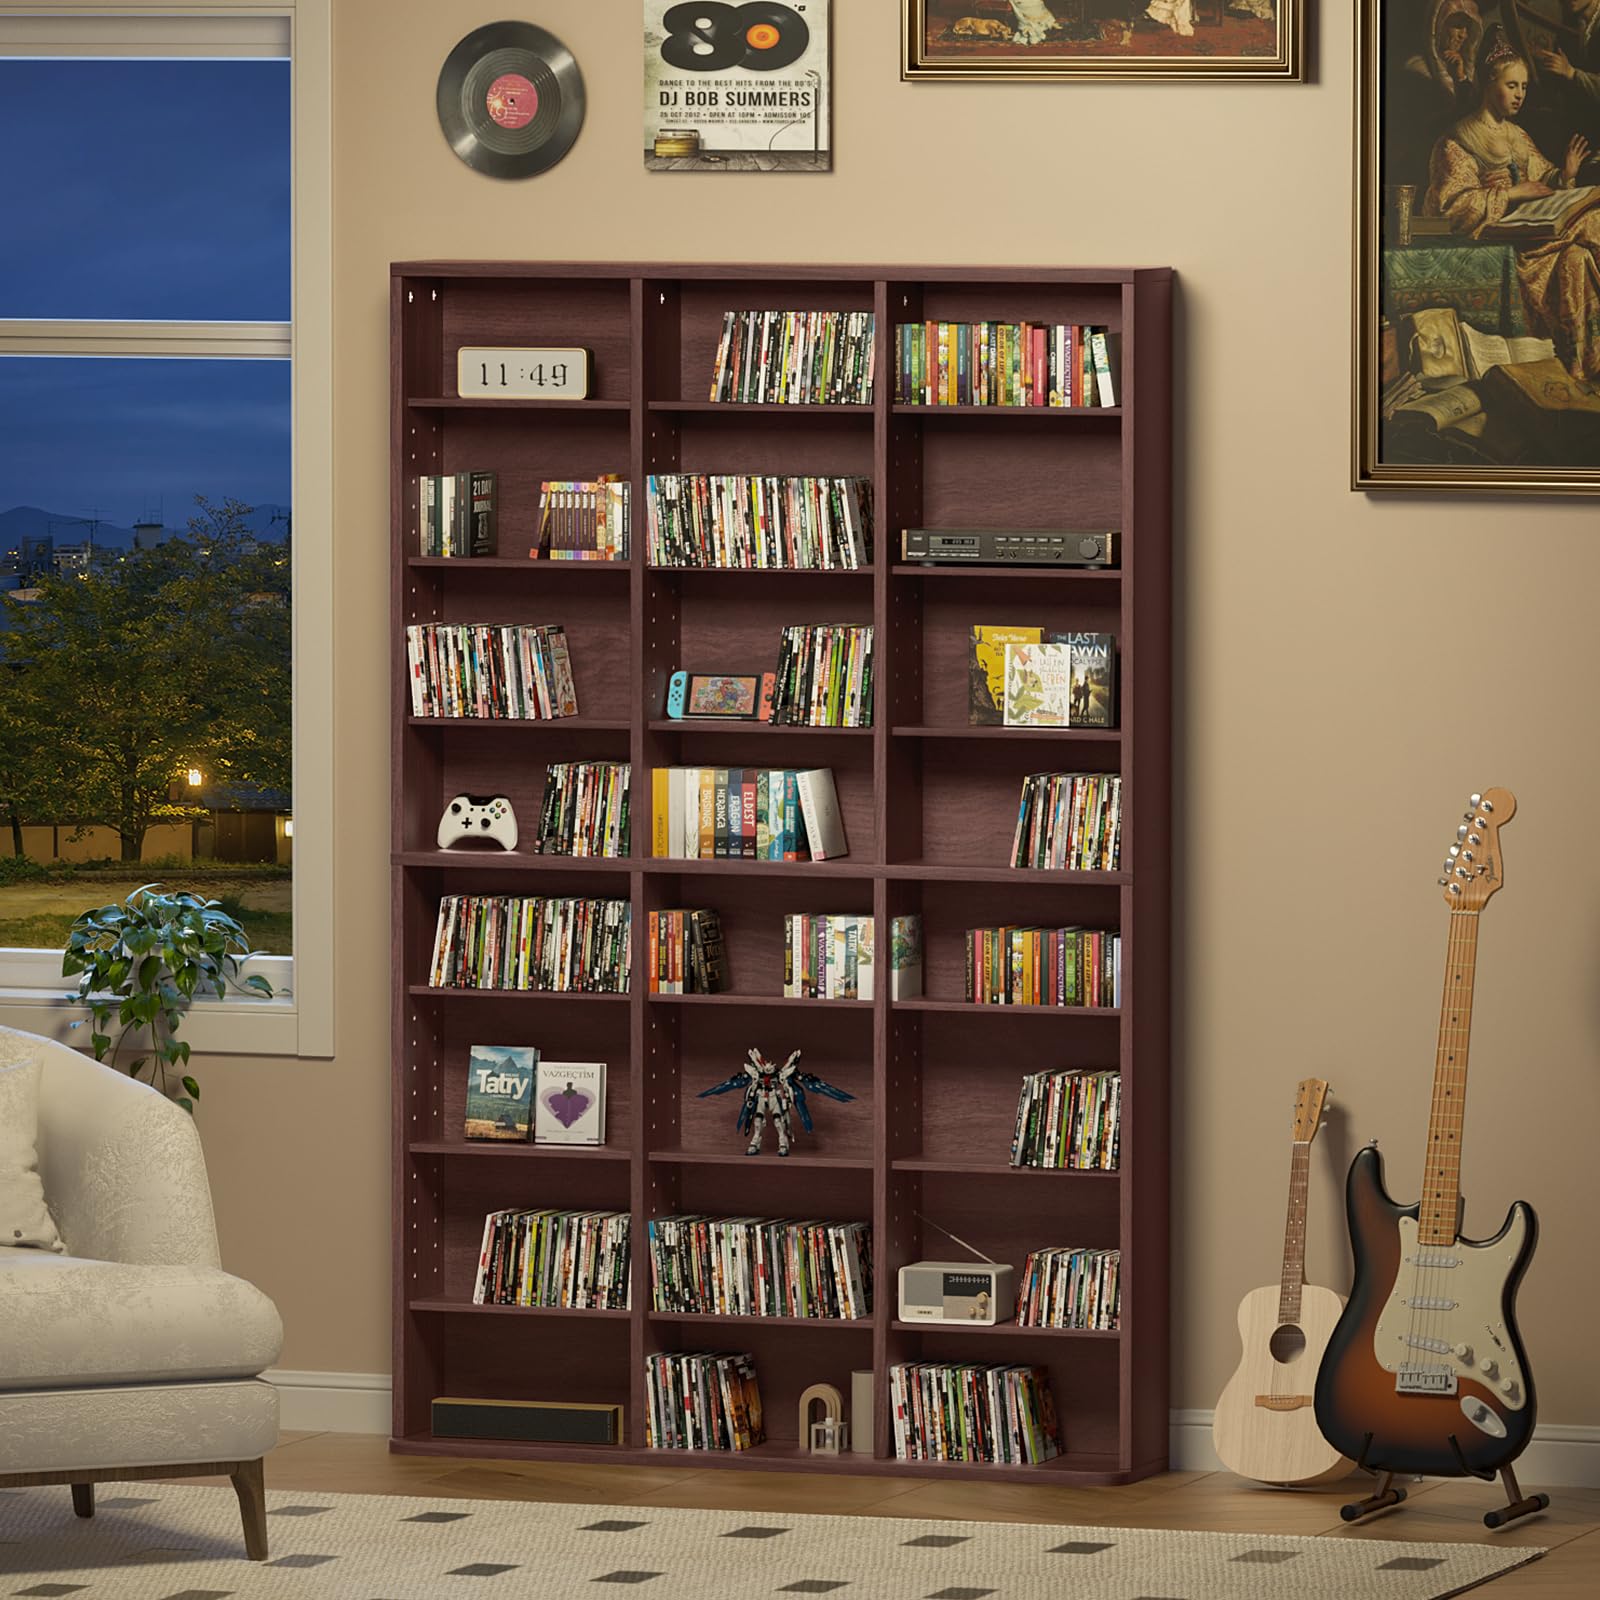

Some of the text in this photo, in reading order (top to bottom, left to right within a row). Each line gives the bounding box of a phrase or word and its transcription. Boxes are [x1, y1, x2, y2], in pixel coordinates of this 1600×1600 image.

[659, 79, 682, 87] DANCE
[686, 79, 696, 87] TO
[698, 79, 711, 87] THE
[714, 79, 733, 87] BEST
[736, 79, 752, 87] HITS
[755, 79, 775, 87] FROM
[779, 79, 791, 87] THE
[660, 91, 811, 106] DJ BOB SUMMERS
[1068, 632, 1099, 644] LAST
[1070, 645, 1108, 658] AWN
[743, 791, 755, 827] ELDEST
[848, 930, 857, 953] TATRY
[543, 1070, 595, 1080] VAZGEÇTİM
[476, 1069, 529, 1100] Tatry
